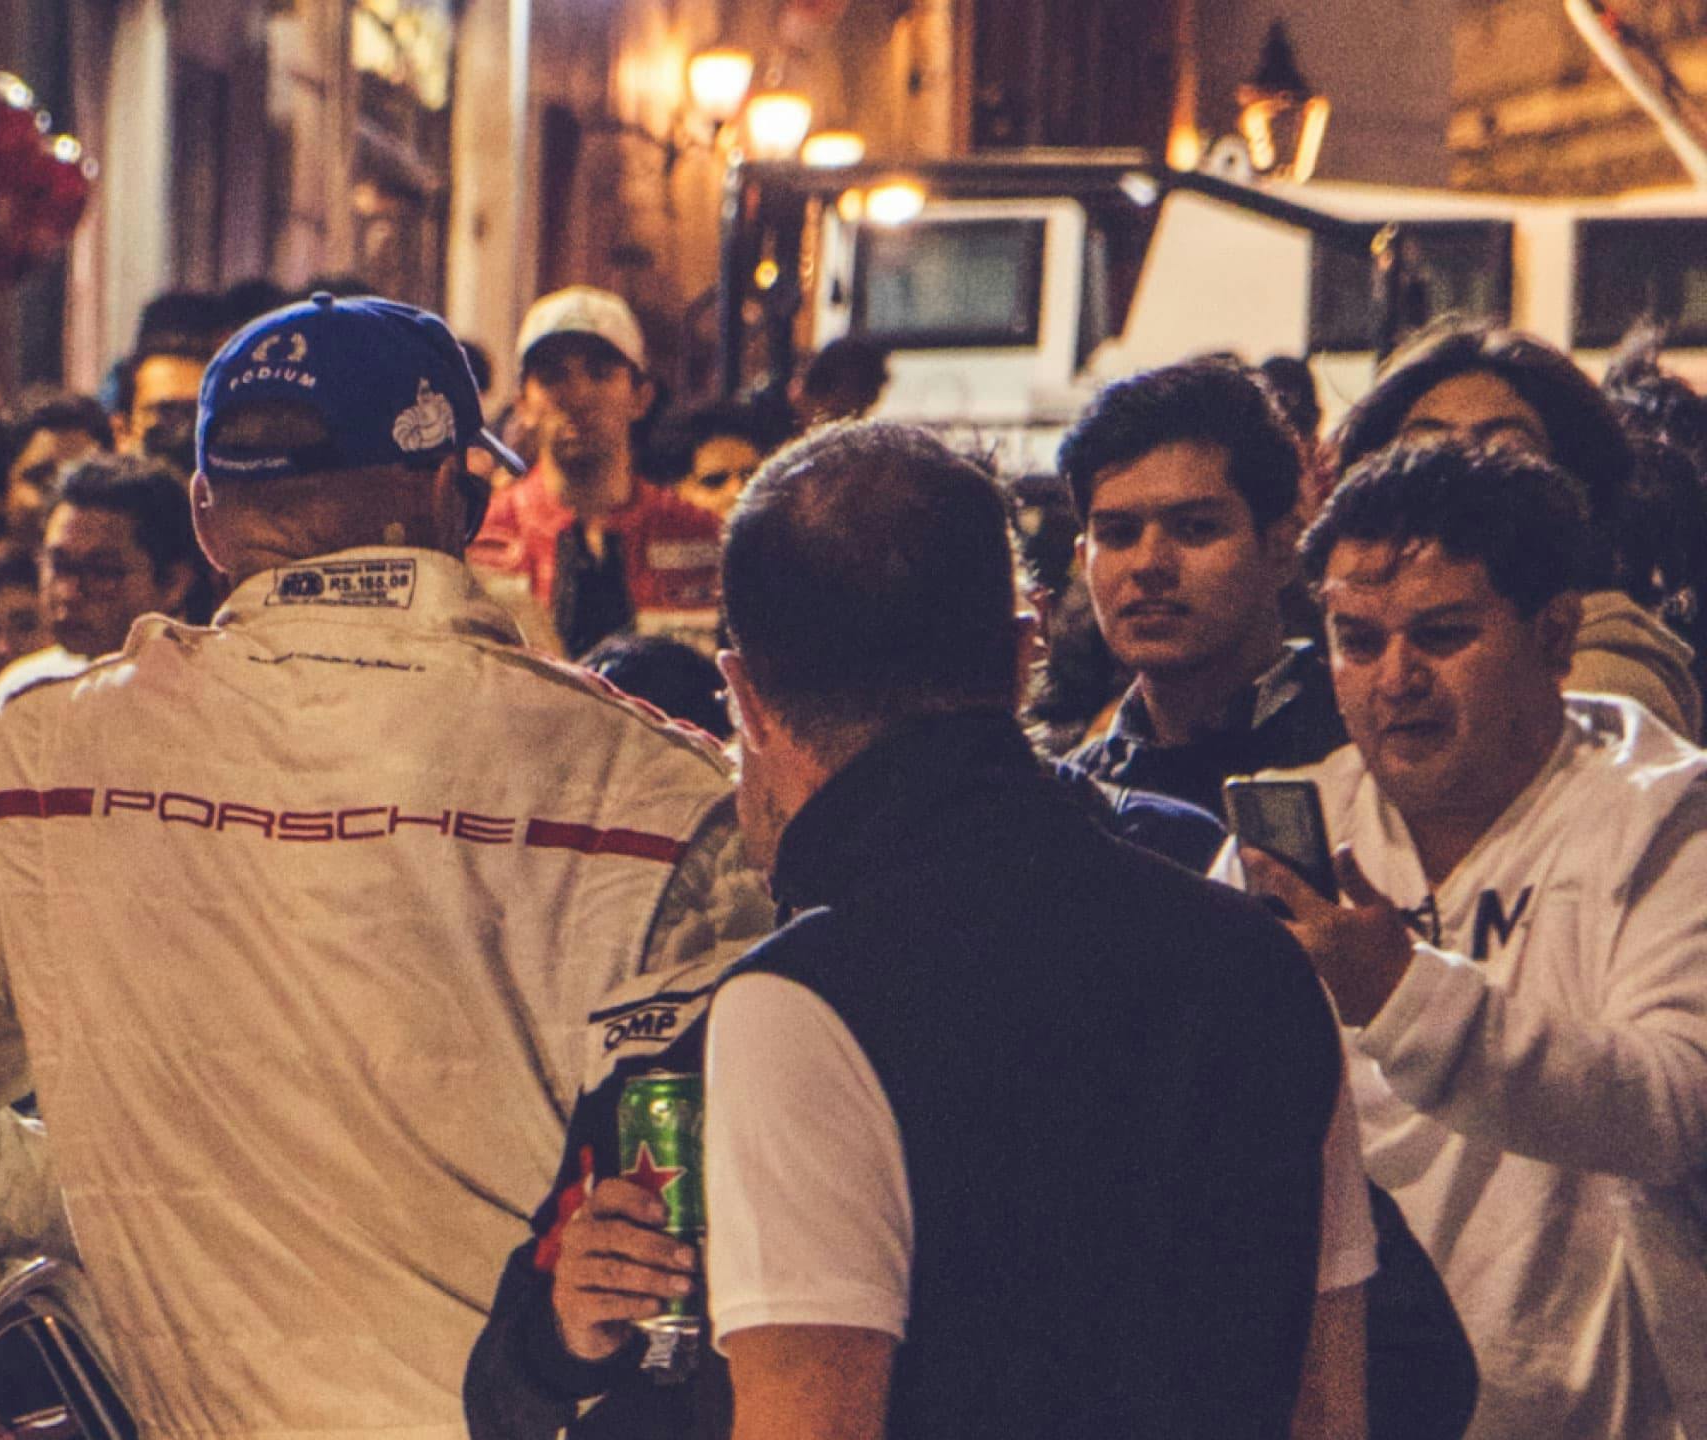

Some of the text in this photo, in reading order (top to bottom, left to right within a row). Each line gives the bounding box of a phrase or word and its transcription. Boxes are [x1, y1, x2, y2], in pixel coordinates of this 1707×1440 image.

[229, 366, 316, 391] PODIUM
[103, 787, 516, 844] PORSCHE
[604, 1008, 678, 1050] OMP
